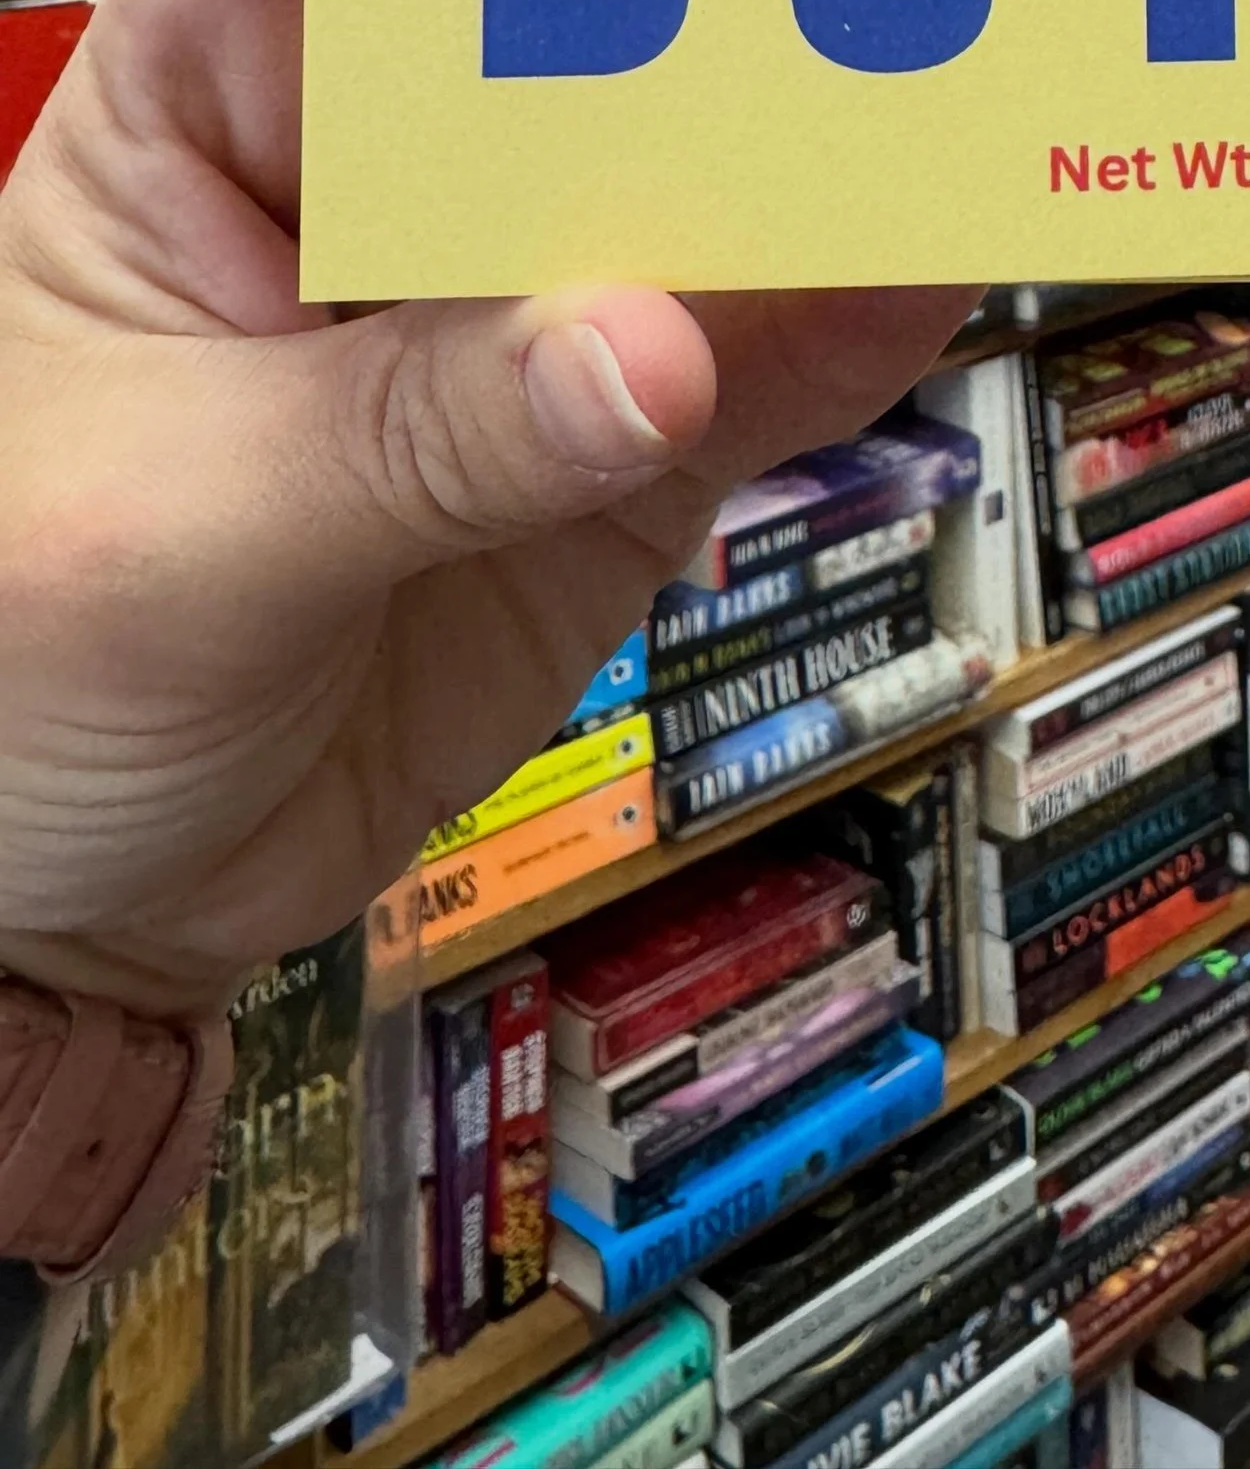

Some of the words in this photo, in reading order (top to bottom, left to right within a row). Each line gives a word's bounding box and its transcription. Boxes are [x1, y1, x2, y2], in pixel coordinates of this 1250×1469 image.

[1050, 145, 1154, 192] Net
[703, 656, 801, 737] NINTH
[802, 616, 896, 693] HOUSE
[880, 1338, 982, 1444] BLAKE
